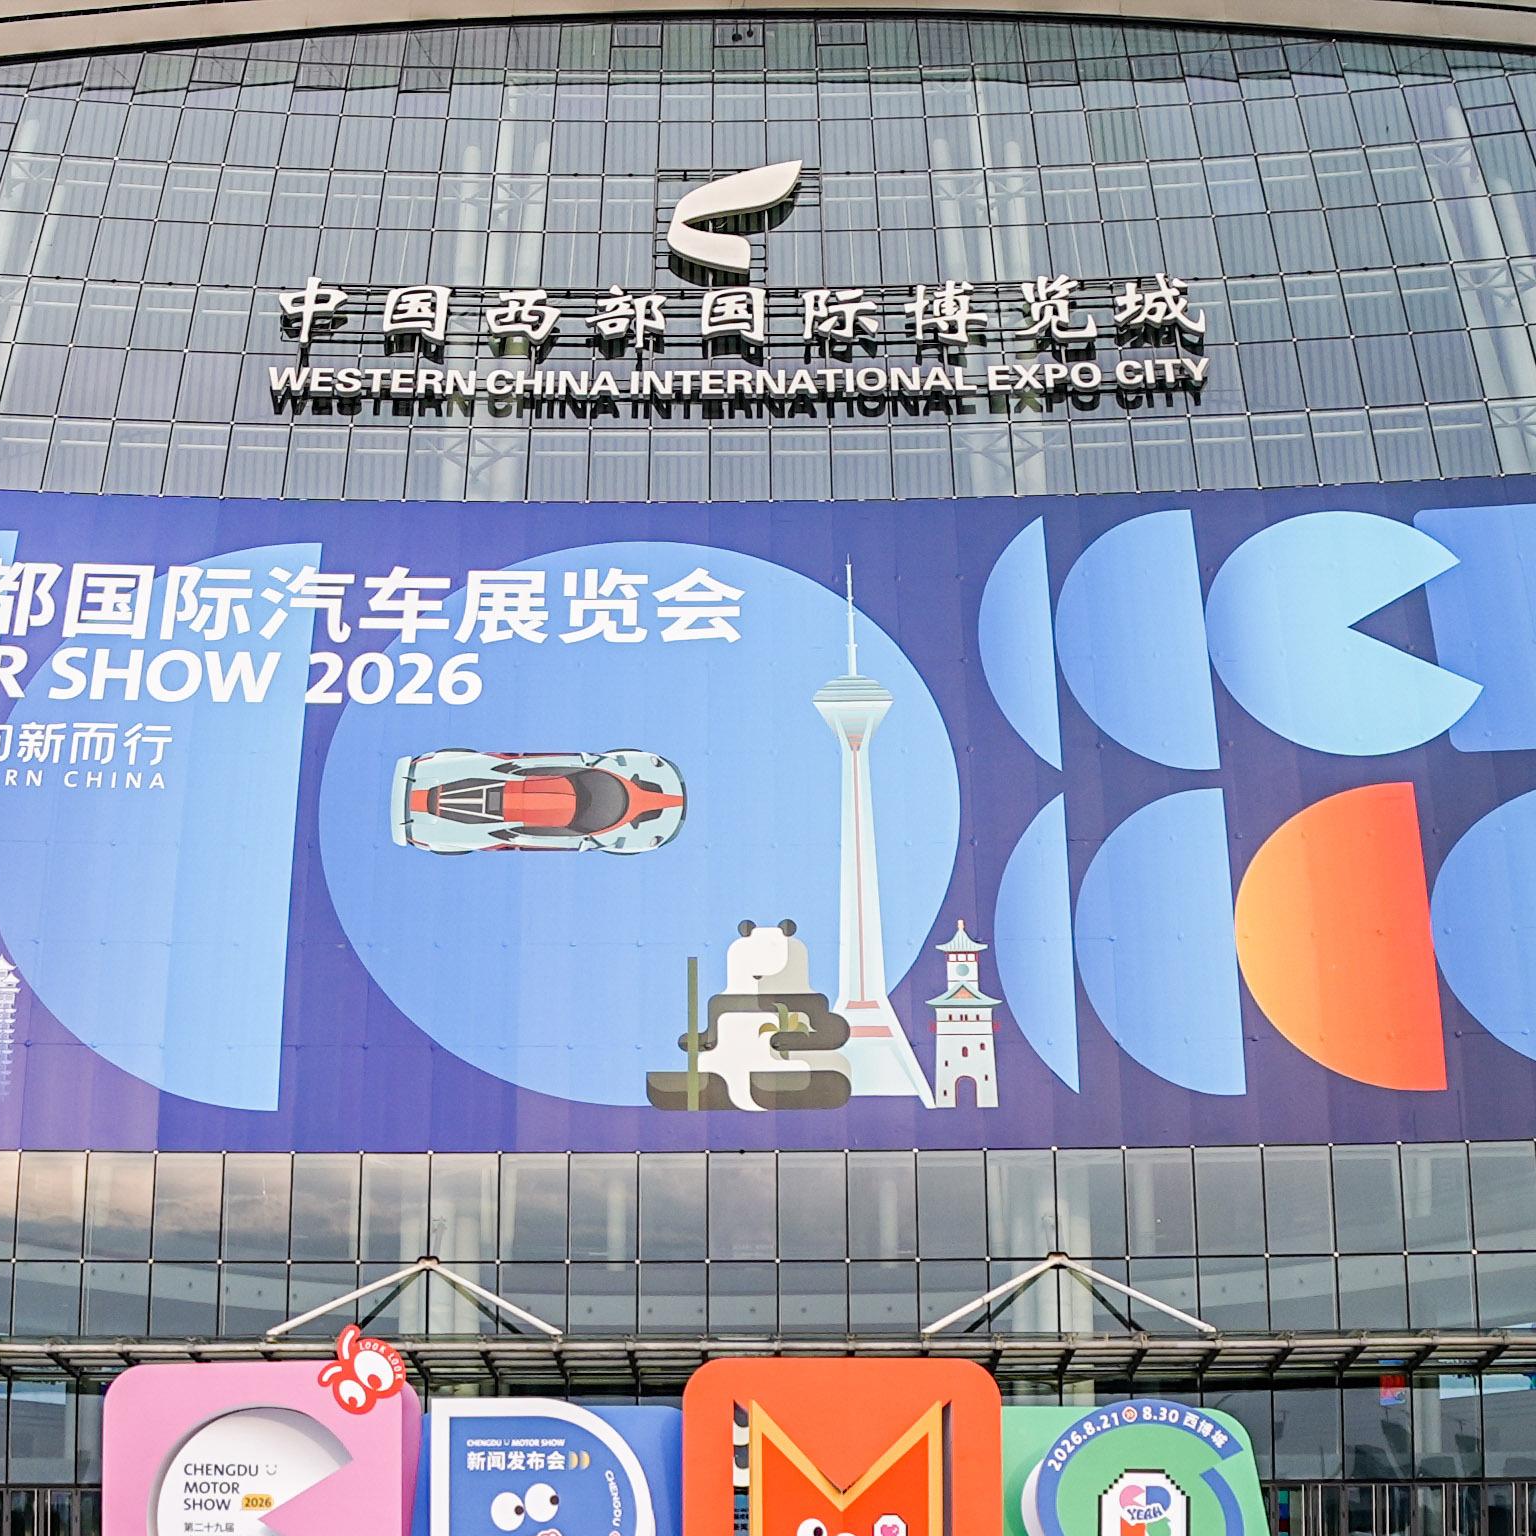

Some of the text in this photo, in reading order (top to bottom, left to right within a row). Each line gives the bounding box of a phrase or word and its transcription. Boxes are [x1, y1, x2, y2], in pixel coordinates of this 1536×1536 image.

[278, 273, 1207, 349] 中国西部国际博览城
[268, 357, 1211, 399] WESTERN CHINA INTERNATIONAL EXPO CITY
[47, 648, 282, 703] SHOW
[304, 652, 485, 705] 2026
[63, 769, 167, 790] CHINA
[1047, 1406, 1180, 1472] 2026.8.21 8.30
[1182, 1411, 1229, 1449] 西博城
[466, 1439, 566, 1448] CHENGDU MOTOR SHOW
[183, 1463, 259, 1477] CHENGDU
[466, 1451, 566, 1471] 新闻发布会
[183, 1481, 241, 1495] MOTOR
[604, 1469, 623, 1527] CHENGDU
[183, 1497, 273, 1511] SHOW 2026
[1126, 1504, 1164, 1521] YEAH
[183, 1522, 235, 1533] 第二十九届
